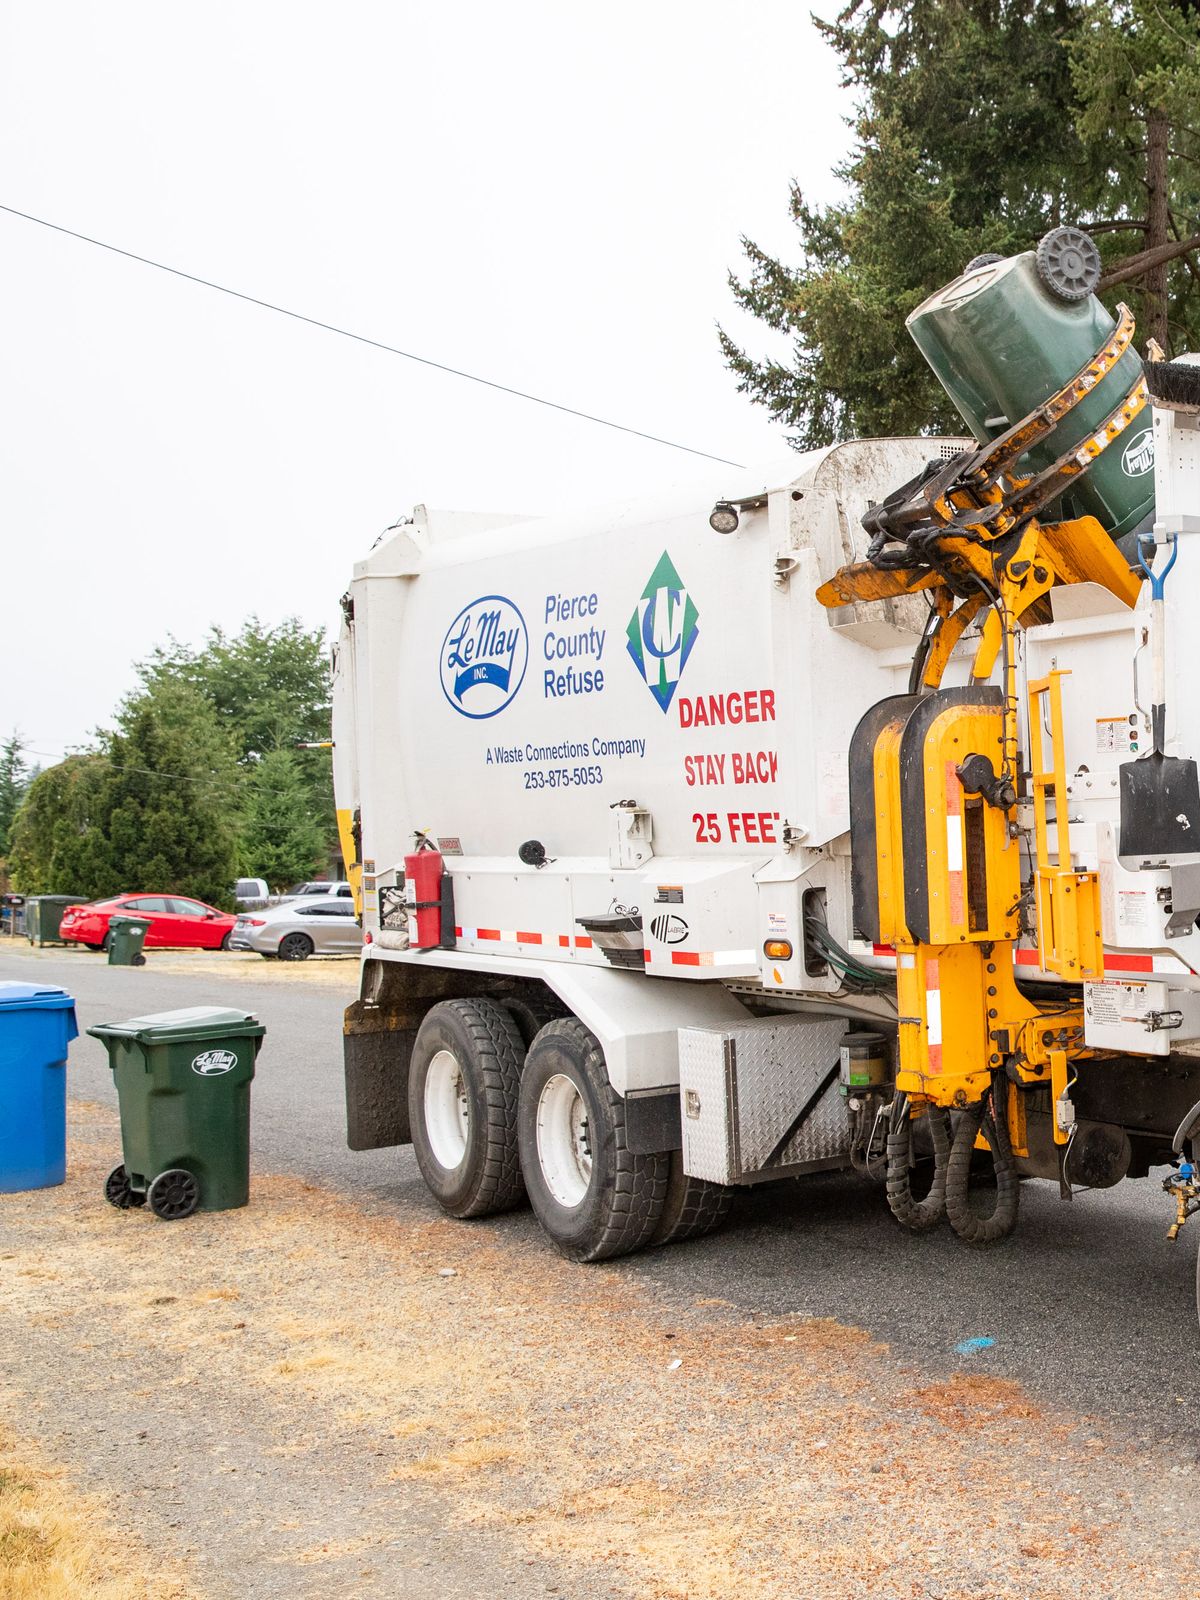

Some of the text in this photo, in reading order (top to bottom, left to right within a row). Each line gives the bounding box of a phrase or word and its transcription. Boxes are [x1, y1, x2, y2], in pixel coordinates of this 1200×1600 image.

[1125, 441, 1154, 474] eMay
[545, 593, 598, 624] Pierce
[447, 610, 519, 686] LeMay
[543, 626, 606, 661] County
[473, 666, 489, 680] INC.
[543, 666, 604, 698] Refuse
[678, 689, 776, 728] DANGER
[486, 737, 646, 765] A Waste Connections Company
[523, 765, 604, 789] 253-875-5053
[684, 753, 726, 787] STAY
[692, 812, 780, 843] 25 FEE
[196, 1052, 234, 1069] LeMay
